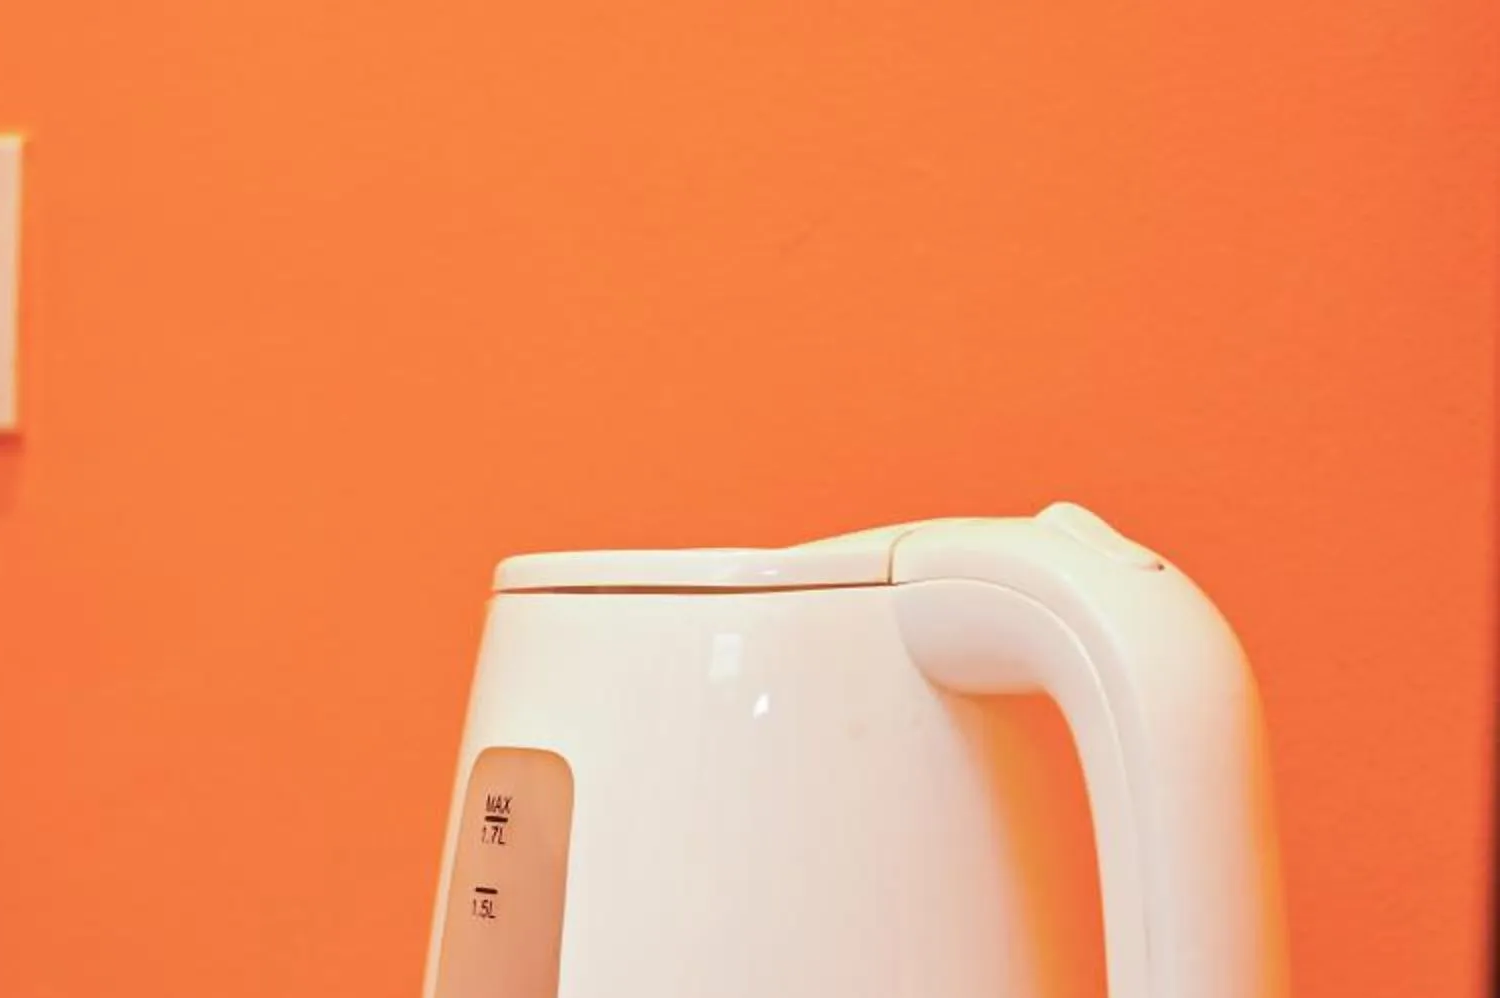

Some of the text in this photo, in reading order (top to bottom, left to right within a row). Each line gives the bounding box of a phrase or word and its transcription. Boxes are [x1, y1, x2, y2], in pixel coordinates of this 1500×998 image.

[485, 795, 511, 815] MAX
[481, 825, 506, 845] 1.7L
[472, 899, 496, 919] 1.5L
